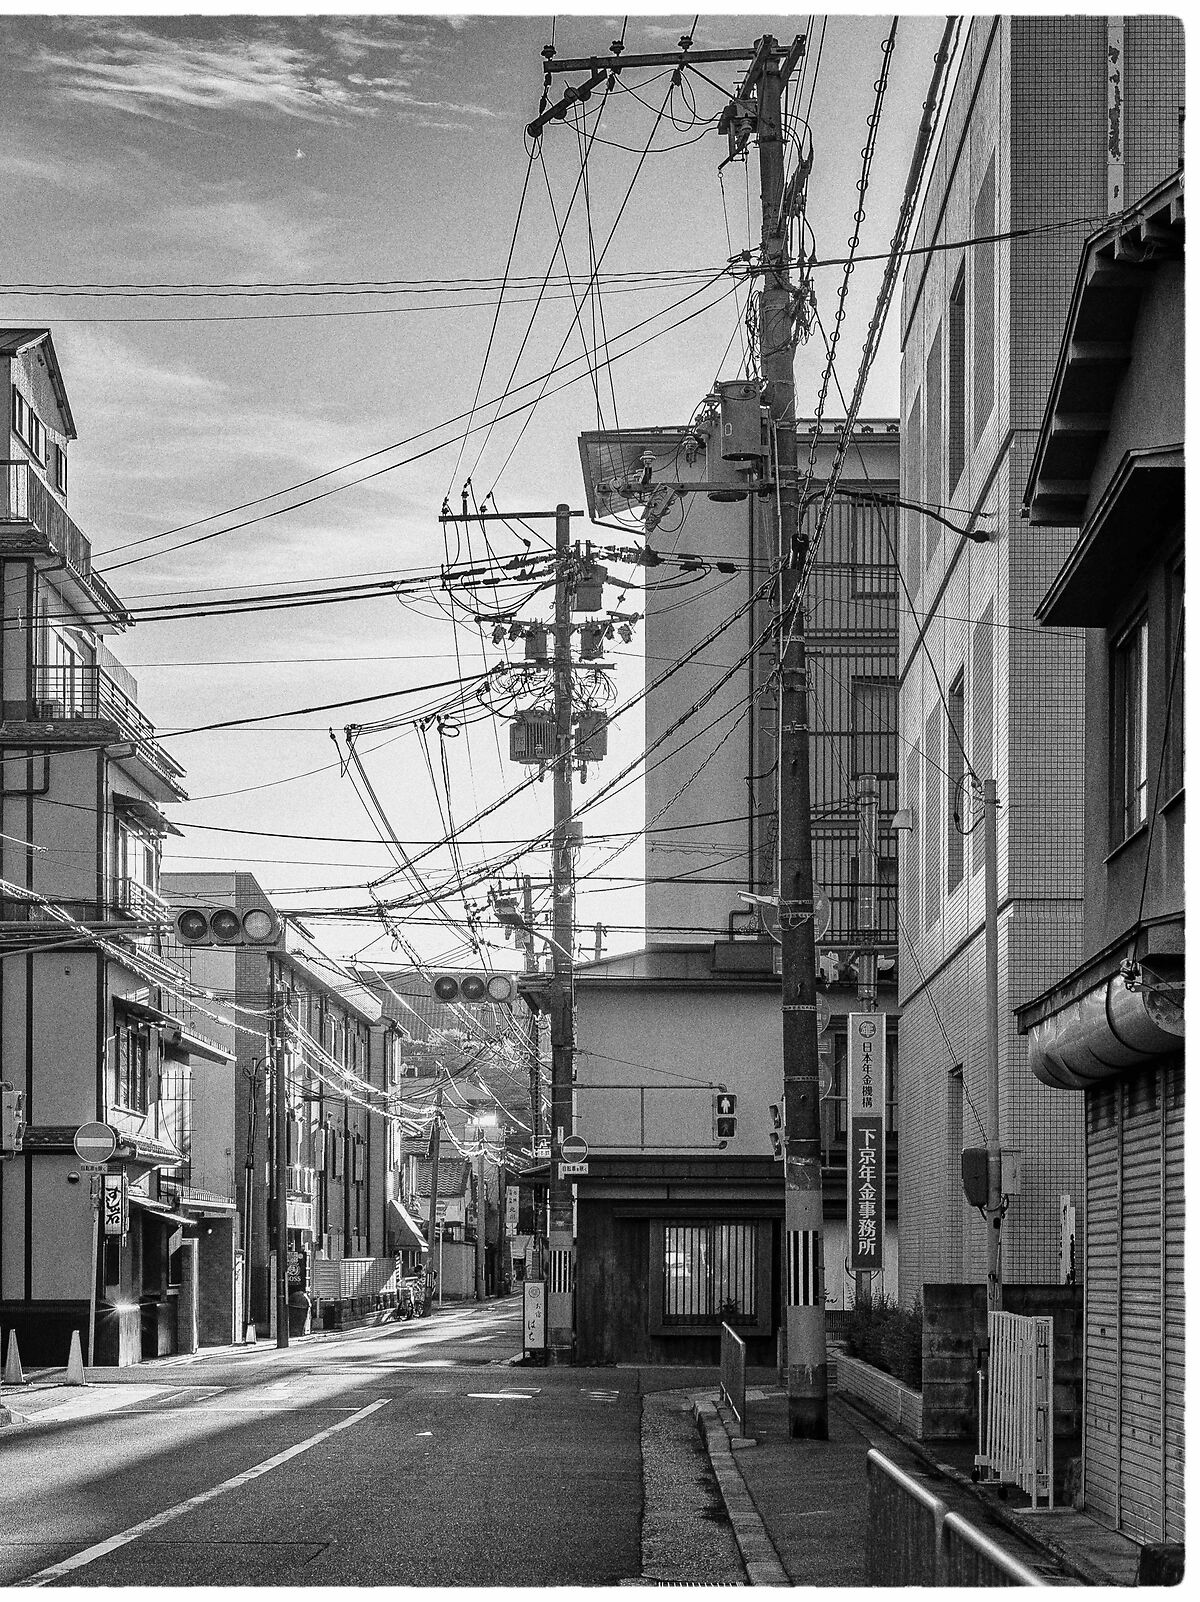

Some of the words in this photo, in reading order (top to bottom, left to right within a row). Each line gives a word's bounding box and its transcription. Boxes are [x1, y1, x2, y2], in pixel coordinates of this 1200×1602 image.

[862, 1041, 873, 1108] 日本年金機構
[858, 1128, 877, 1256] 下京年金事務所
